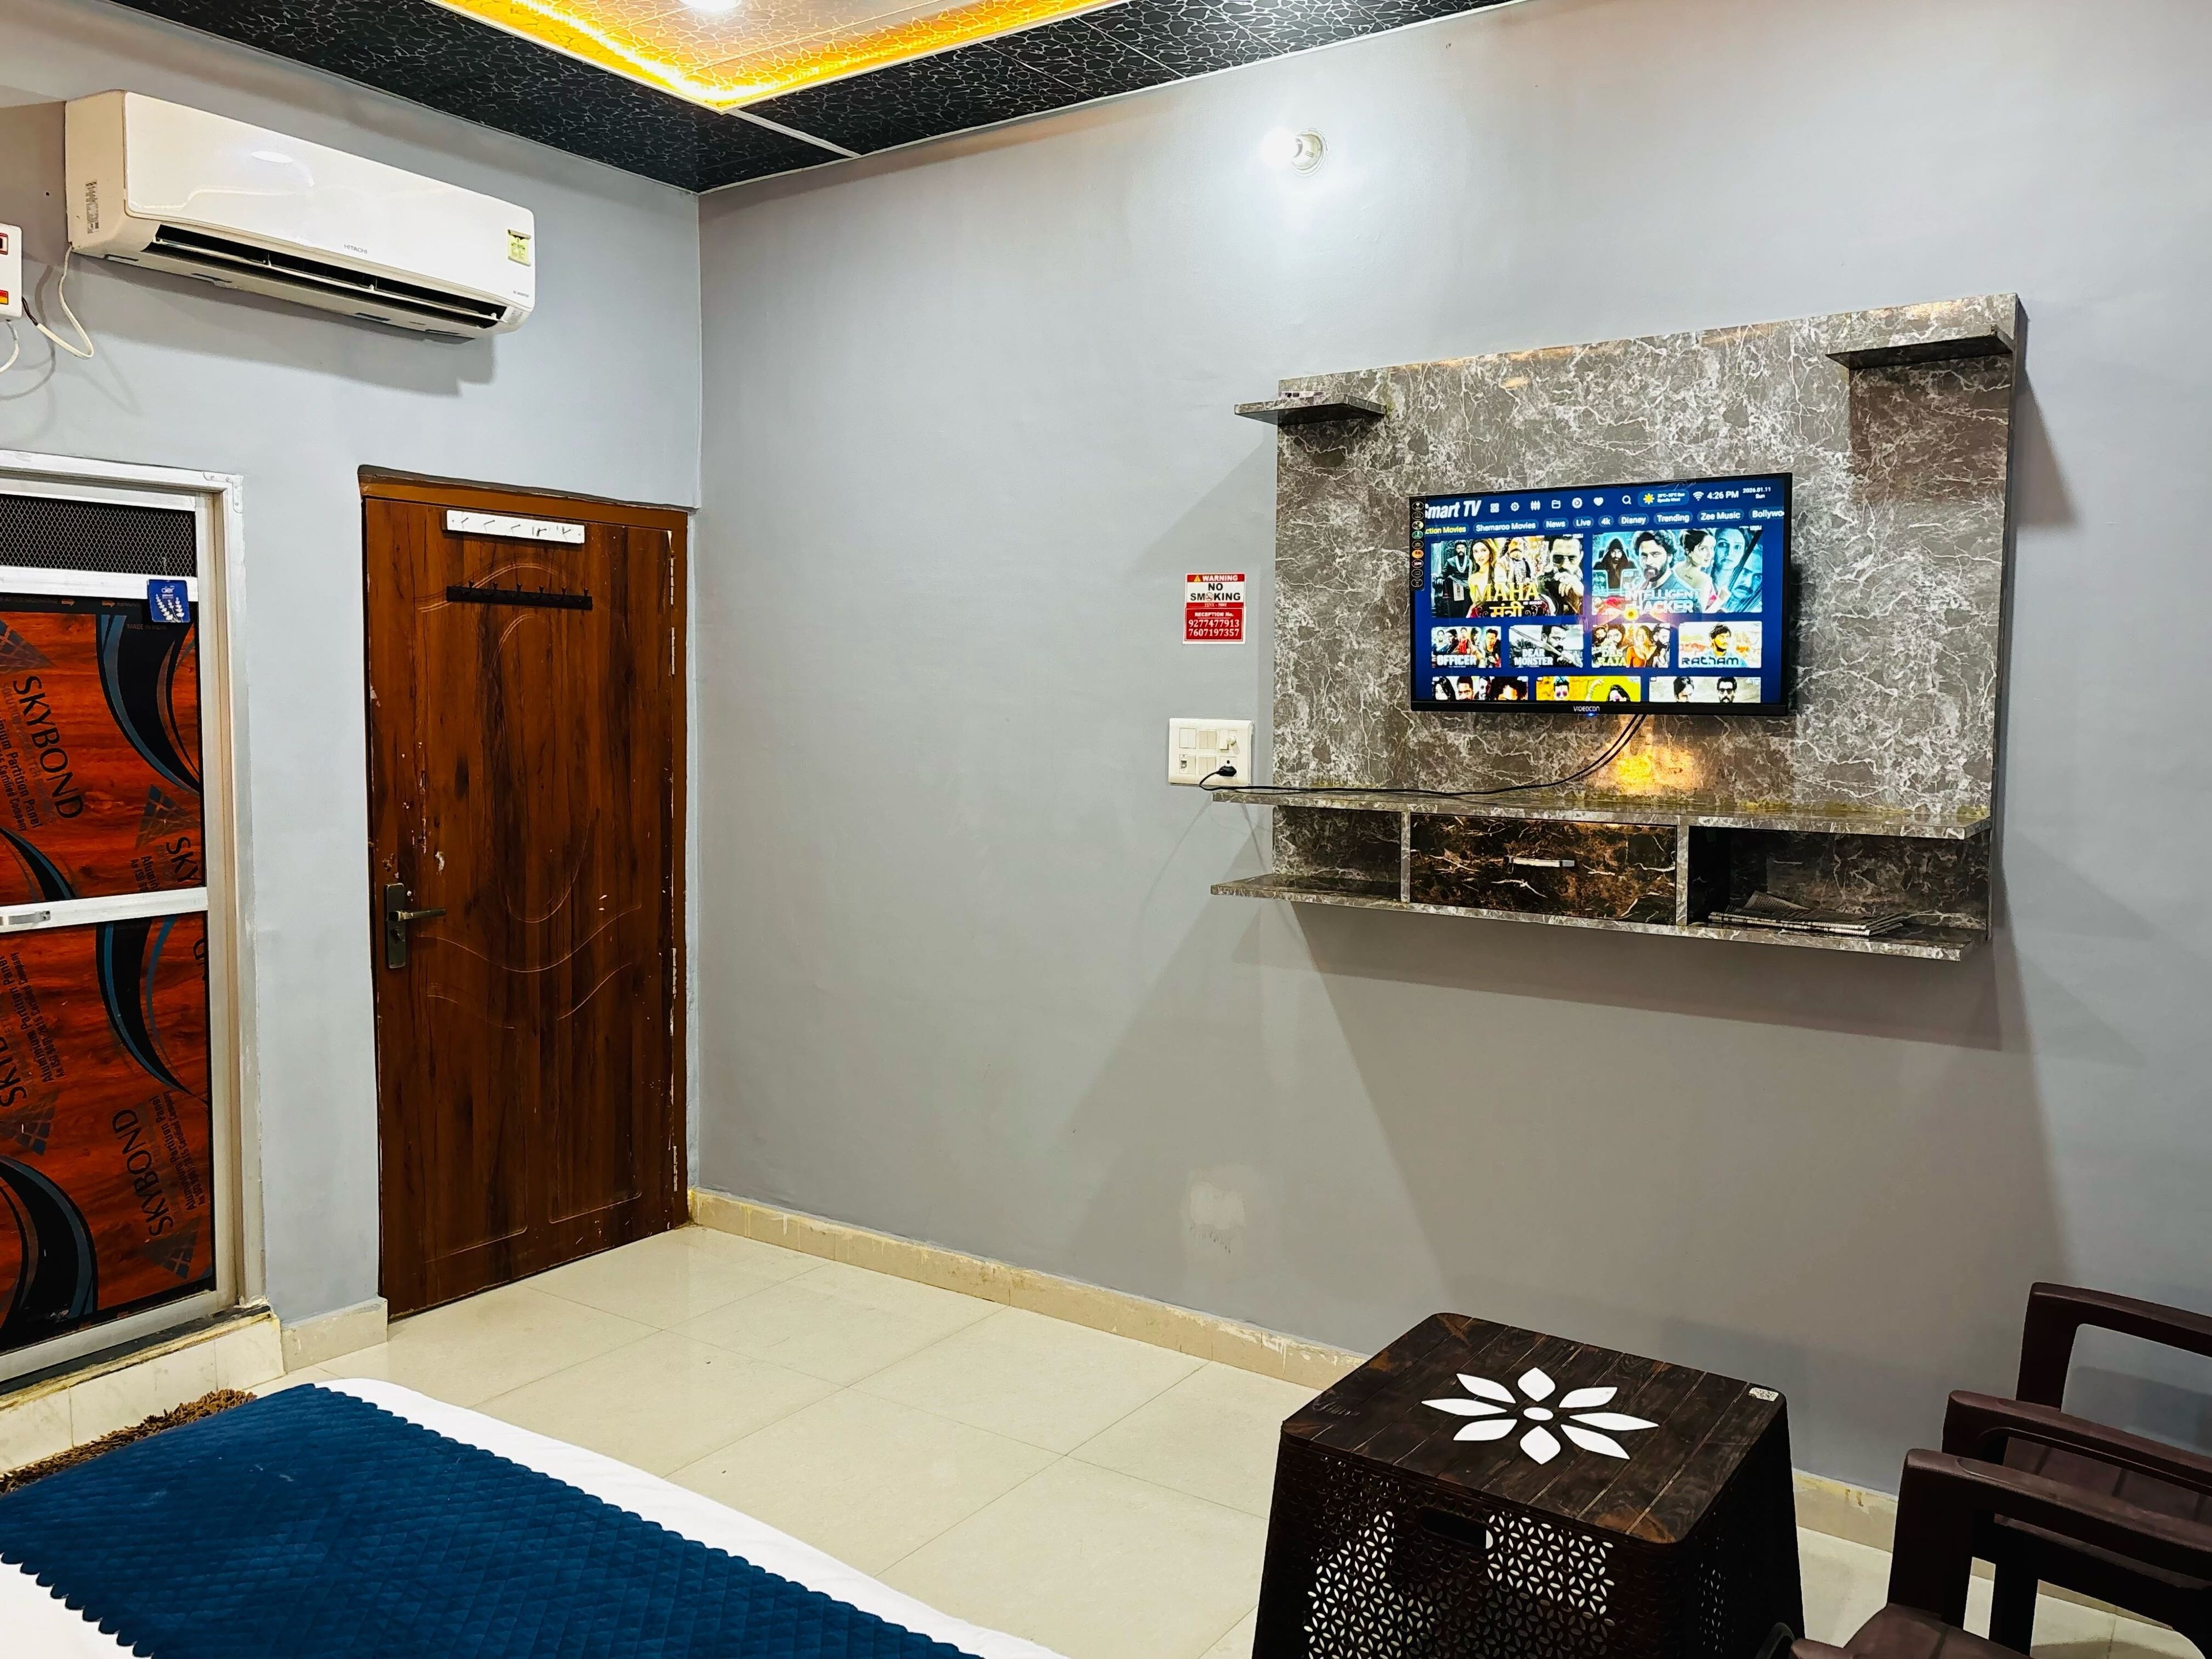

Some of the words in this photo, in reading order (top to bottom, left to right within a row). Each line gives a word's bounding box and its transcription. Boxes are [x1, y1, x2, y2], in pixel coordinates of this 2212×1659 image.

[344, 244, 368, 253] HITACHI
[1707, 491, 1725, 499] 4:26
[1463, 500, 1482, 517] TV
[1601, 517, 1611, 525] 4k
[1621, 516, 1646, 525] Disney
[1657, 514, 1690, 523] Trending
[1700, 512, 1715, 521] Zee
[1717, 511, 1741, 520] Music
[1476, 522, 1510, 532] Shemaroo
[1512, 522, 1536, 530] Movies
[1546, 520, 1566, 528] News
[1425, 527, 1441, 535] ction
[1208, 583, 1224, 591] NO
[1474, 582, 1541, 601] MAHA
[1625, 589, 1700, 600] INTELLIGENT
[1631, 600, 1694, 613] HACKER
[1188, 619, 1240, 627] 9277477913
[1188, 628, 1240, 637] 7607197357
[1522, 649, 1546, 657] DEAR
[1437, 654, 1477, 666] OFFICER
[1514, 657, 1554, 665] MONSTER
[13, 676, 84, 819] SKYBOND
[6, 751, 29, 797] Partition
[23, 798, 44, 830] Panel
[9, 797, 28, 832] Company
[10, 986, 32, 1031] Partition
[149, 1094, 166, 1124] Panel
[111, 1109, 173, 1237] SKYBOND
